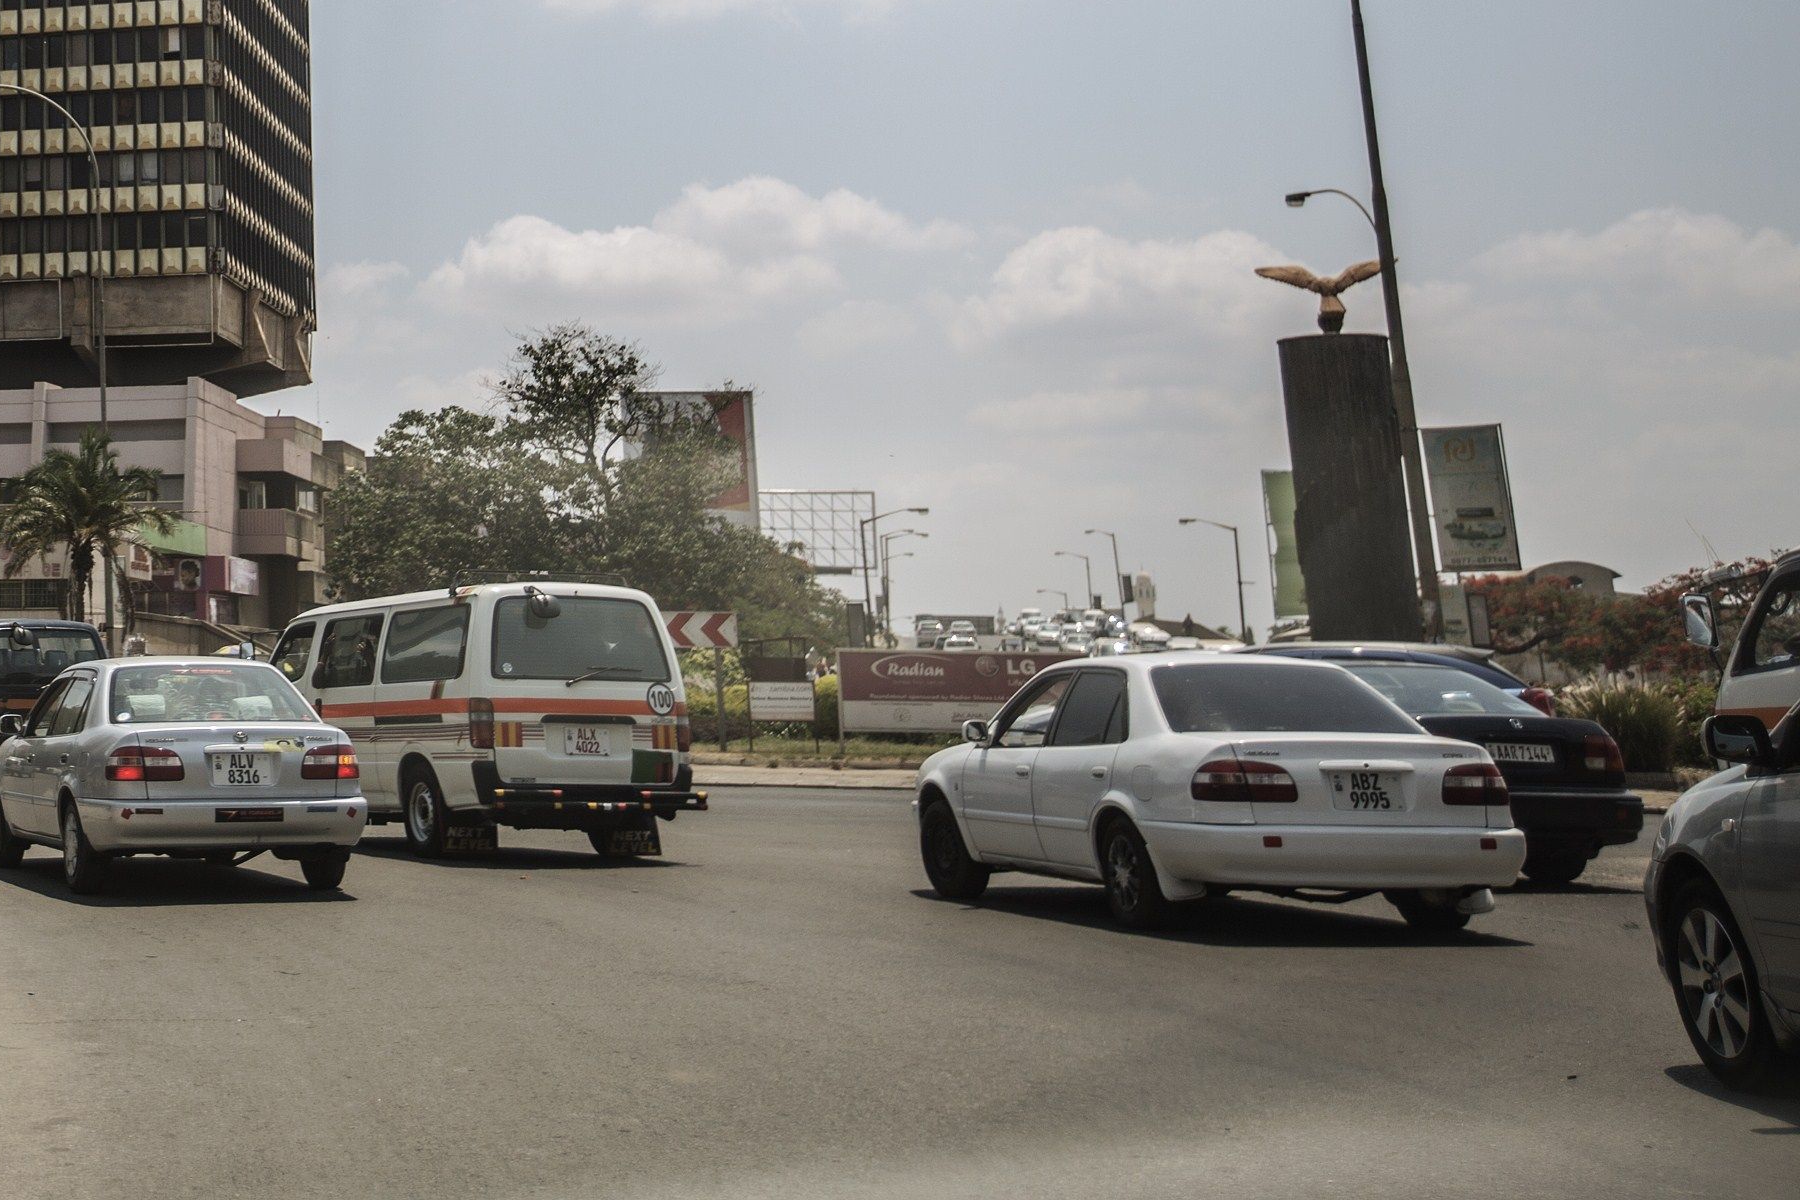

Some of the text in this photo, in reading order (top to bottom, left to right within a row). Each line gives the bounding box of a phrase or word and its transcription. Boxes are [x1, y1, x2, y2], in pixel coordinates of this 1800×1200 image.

[886, 662, 945, 677] Radian
[1006, 659, 1037, 675] LG
[651, 691, 671, 708] 100
[577, 728, 597, 740] ALX
[575, 741, 601, 754] 4022
[230, 754, 254, 768] ALV
[228, 770, 260, 784] 8316
[1351, 773, 1382, 791] ABZ
[1350, 791, 1391, 810] 9995
[448, 827, 485, 837] NEXT
[613, 830, 651, 841] NEXT
